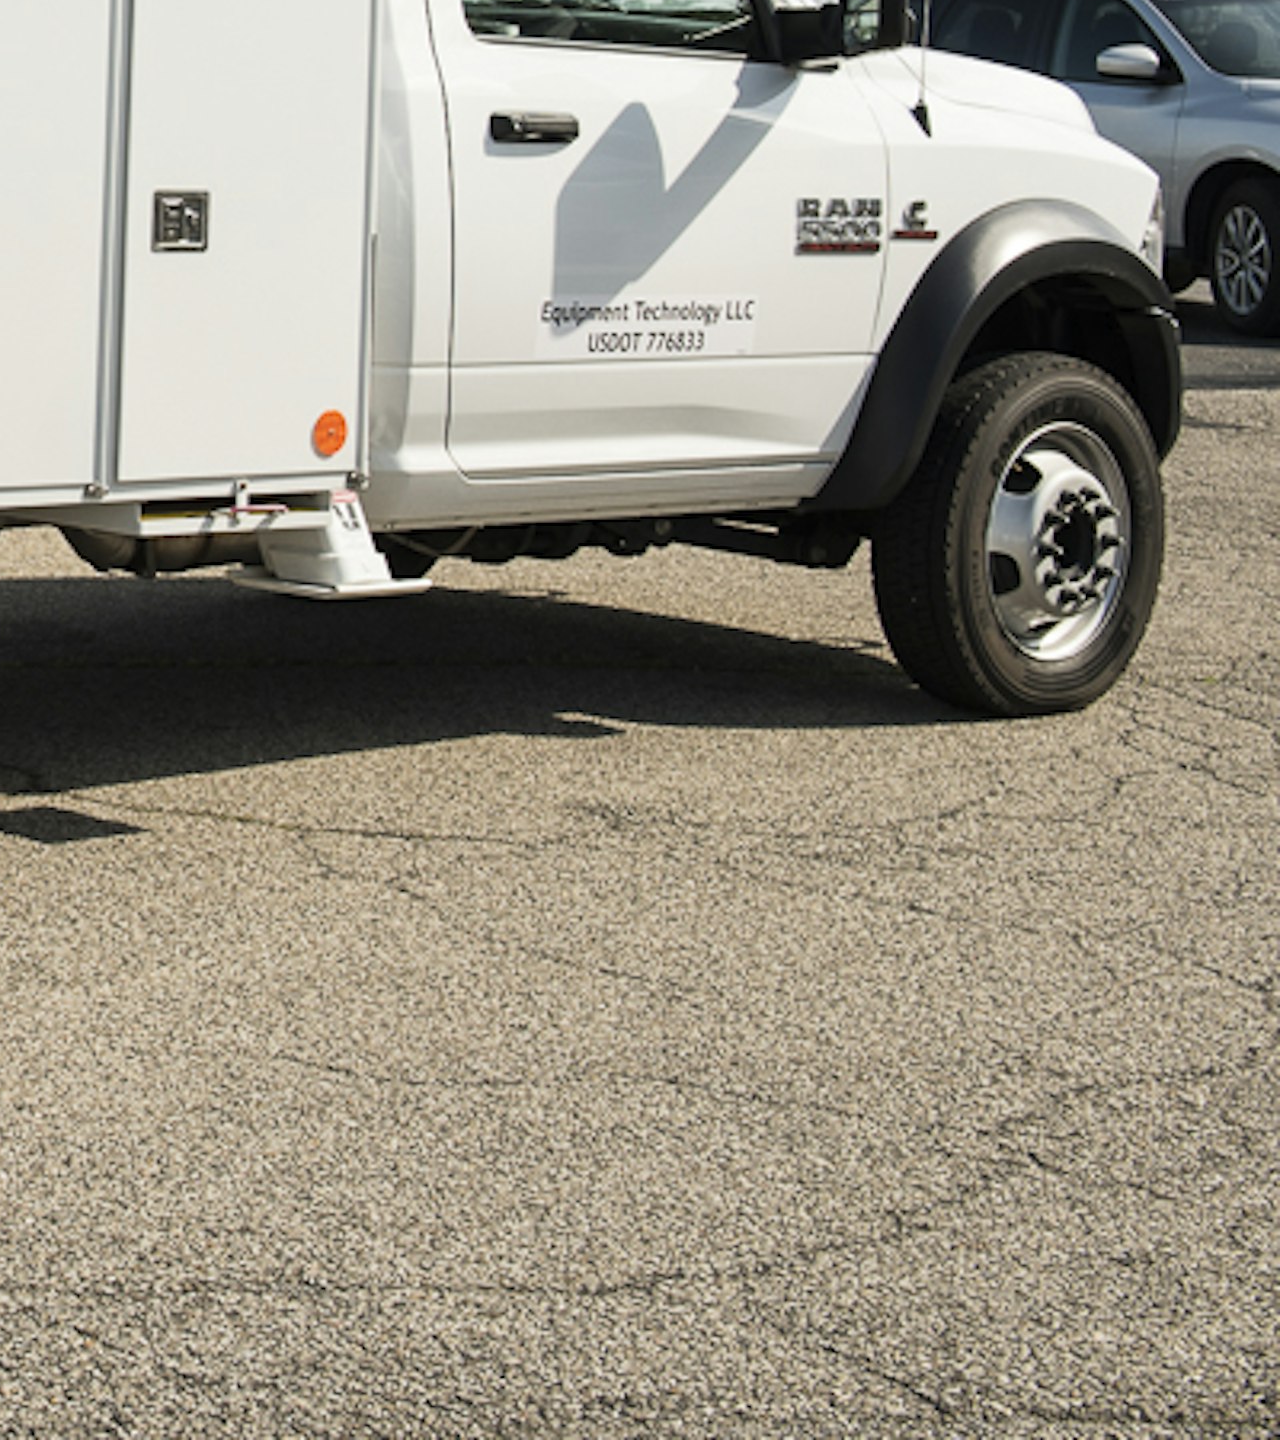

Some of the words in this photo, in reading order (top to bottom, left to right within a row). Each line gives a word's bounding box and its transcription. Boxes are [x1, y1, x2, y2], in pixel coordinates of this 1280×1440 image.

[797, 199, 882, 218] RAM
[797, 219, 881, 243] 5500
[541, 301, 628, 326] Equipment
[634, 301, 721, 325] Technology
[725, 301, 755, 321] LLC
[589, 332, 643, 352] USDOT
[647, 332, 704, 352] 776833
